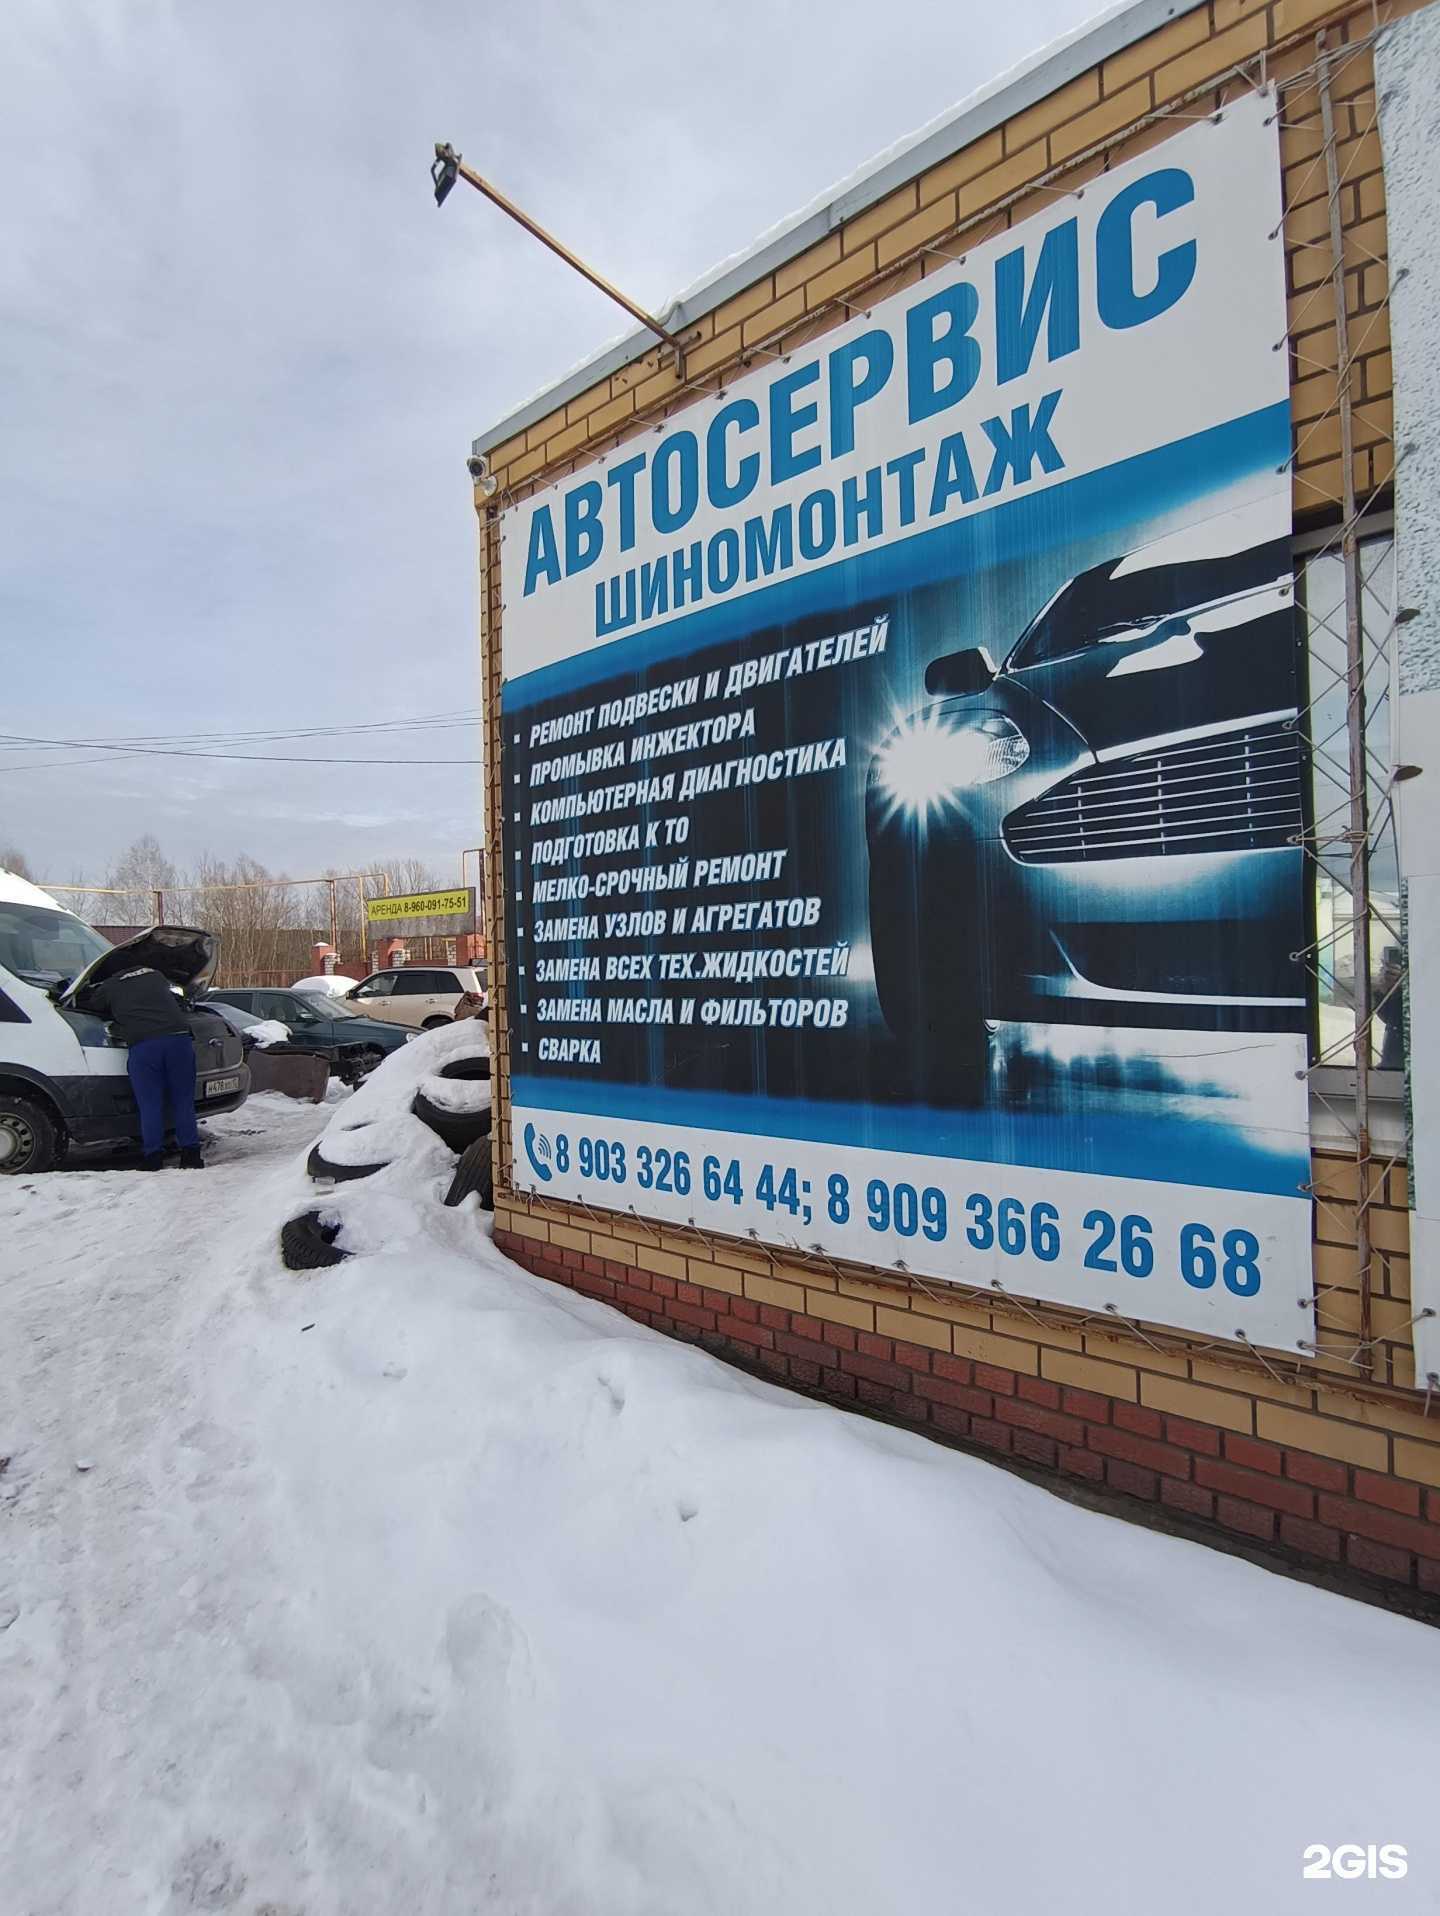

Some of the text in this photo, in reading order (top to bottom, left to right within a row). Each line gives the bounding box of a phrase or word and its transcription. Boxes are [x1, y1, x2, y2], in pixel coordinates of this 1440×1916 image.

[522, 167, 1197, 598] АВТОСЕРВИС
[595, 389, 1066, 638] ШИНОМОНТАЖ
[529, 613, 888, 749] РЕМОНТ ПОДВЕСКИ И ДВИГАТЕЛЕЙ
[530, 707, 756, 787] ПРОМЫВКА ИНЖЕКТОРА
[530, 736, 847, 826] КОМПЬЮТЕРНАЯ ДИАГНОСТИКА
[531, 816, 690, 866] ПОДГОТОВКА К ТО
[532, 848, 788, 904] МЕЛКО-СРОЧНЫЙ РЕМОНТ
[371, 896, 466, 915] АРЕНДА 8-960-091-75-51
[533, 896, 822, 943] ЗАМЕНА УЗЛОВ И АГРЕГАТОВ
[535, 958, 600, 983] ЗАМЕНА
[605, 954, 652, 981] ВСЕХ
[536, 997, 849, 1029] ЗАМЕНА МАСЛА И ФИЛЬТОРОВ
[538, 1038, 601, 1064] СВАРКА
[556, 1132, 1261, 1297] 8 903 326 64 44; 8 909 366 26 68
